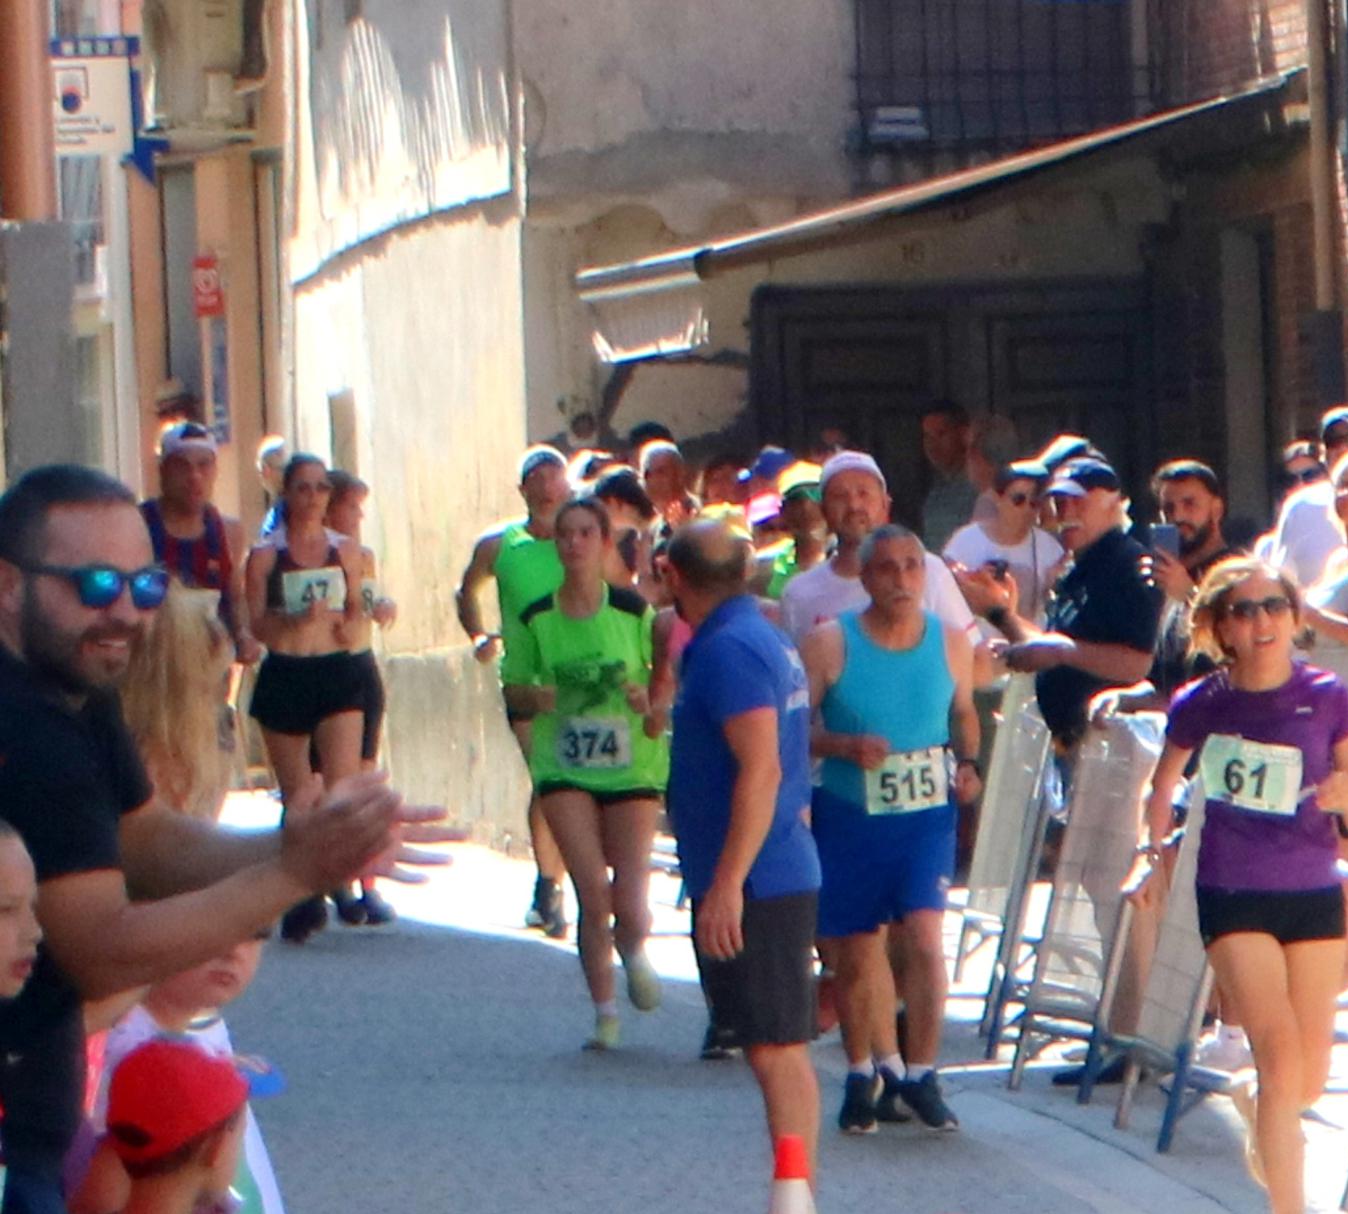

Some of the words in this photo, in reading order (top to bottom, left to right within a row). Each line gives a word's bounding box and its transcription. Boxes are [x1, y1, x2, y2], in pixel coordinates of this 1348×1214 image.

[301, 580, 328, 603] 47
[564, 729, 618, 760] 374
[880, 766, 936, 804] 515
[1224, 759, 1267, 799] 61
